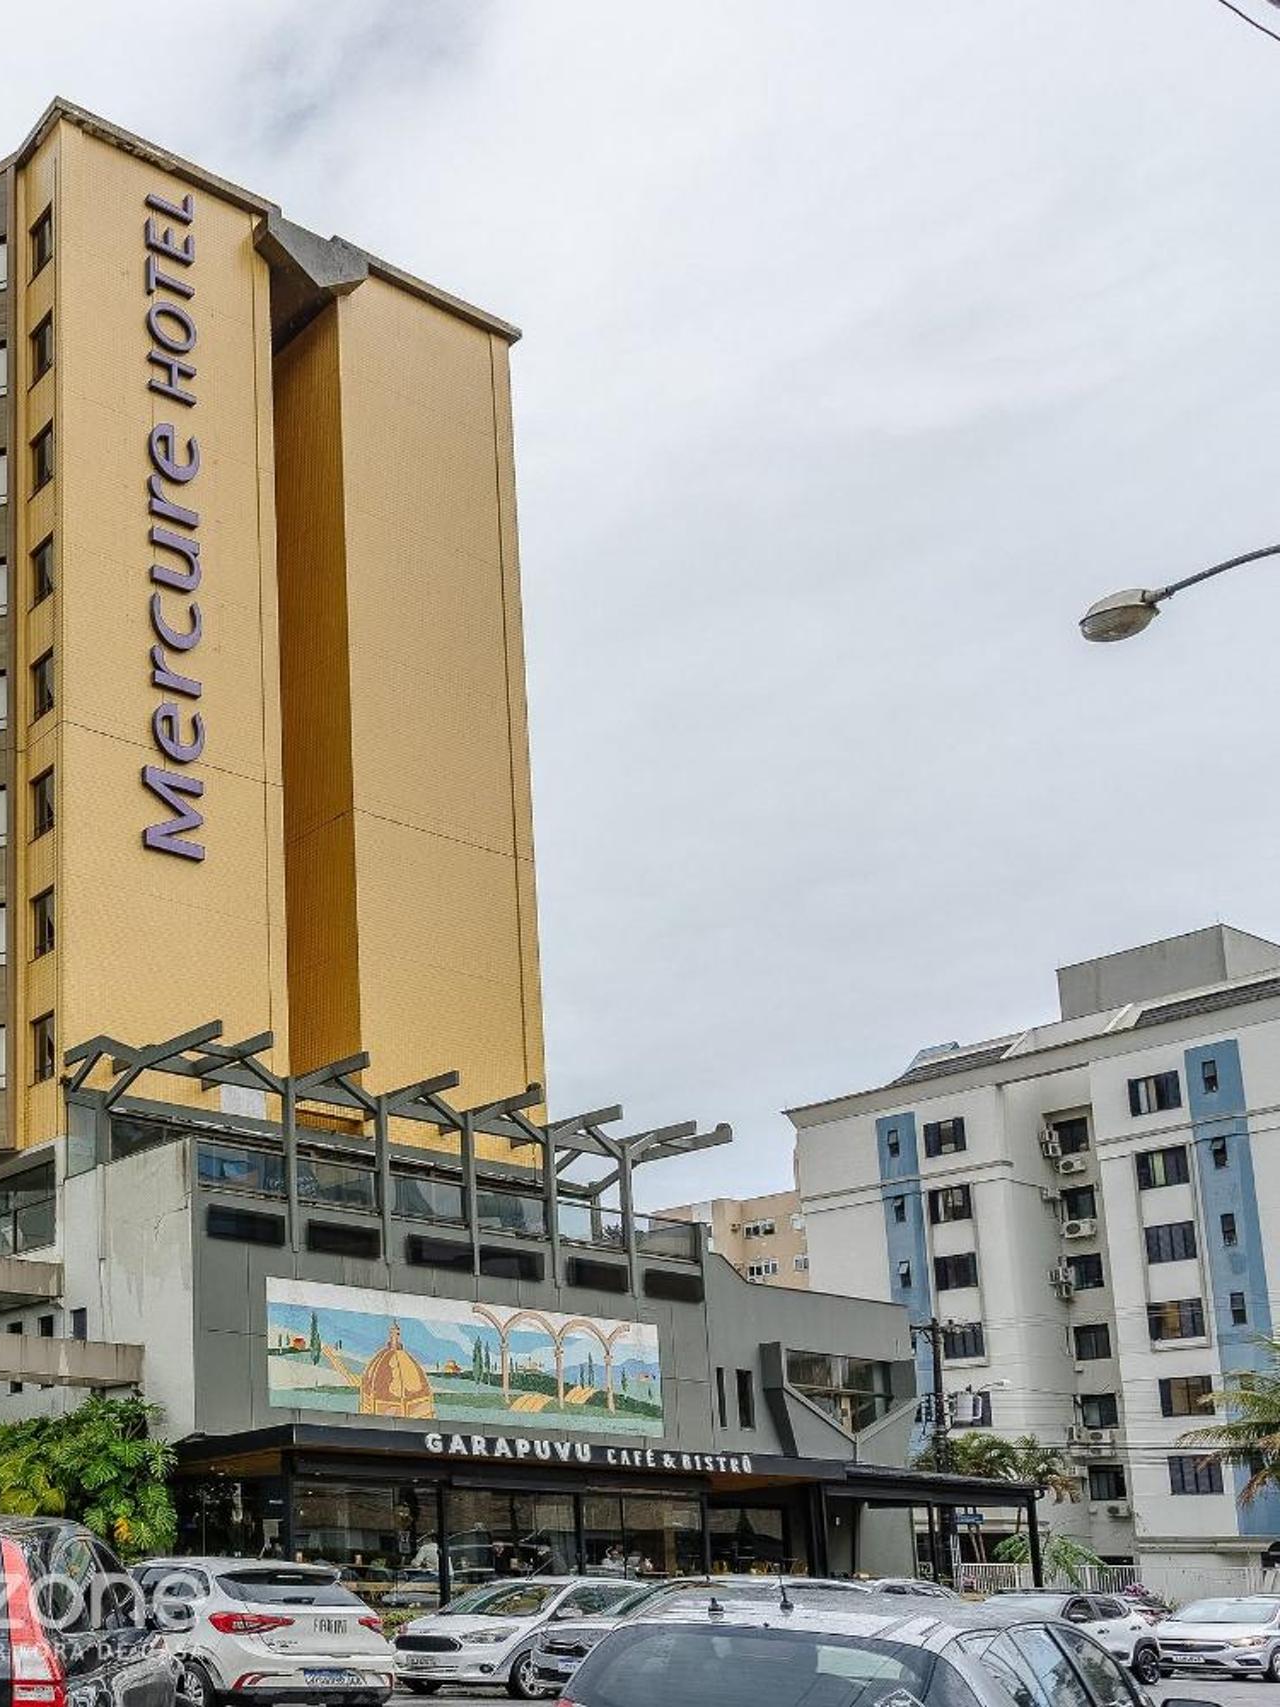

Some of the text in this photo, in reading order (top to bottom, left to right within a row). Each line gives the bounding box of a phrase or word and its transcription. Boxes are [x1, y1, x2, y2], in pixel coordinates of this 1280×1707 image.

[140, 192, 206, 863] Mercure HOTEL
[424, 1432, 753, 1475] GARAPUVU CAFÉ & BISTRÔ
